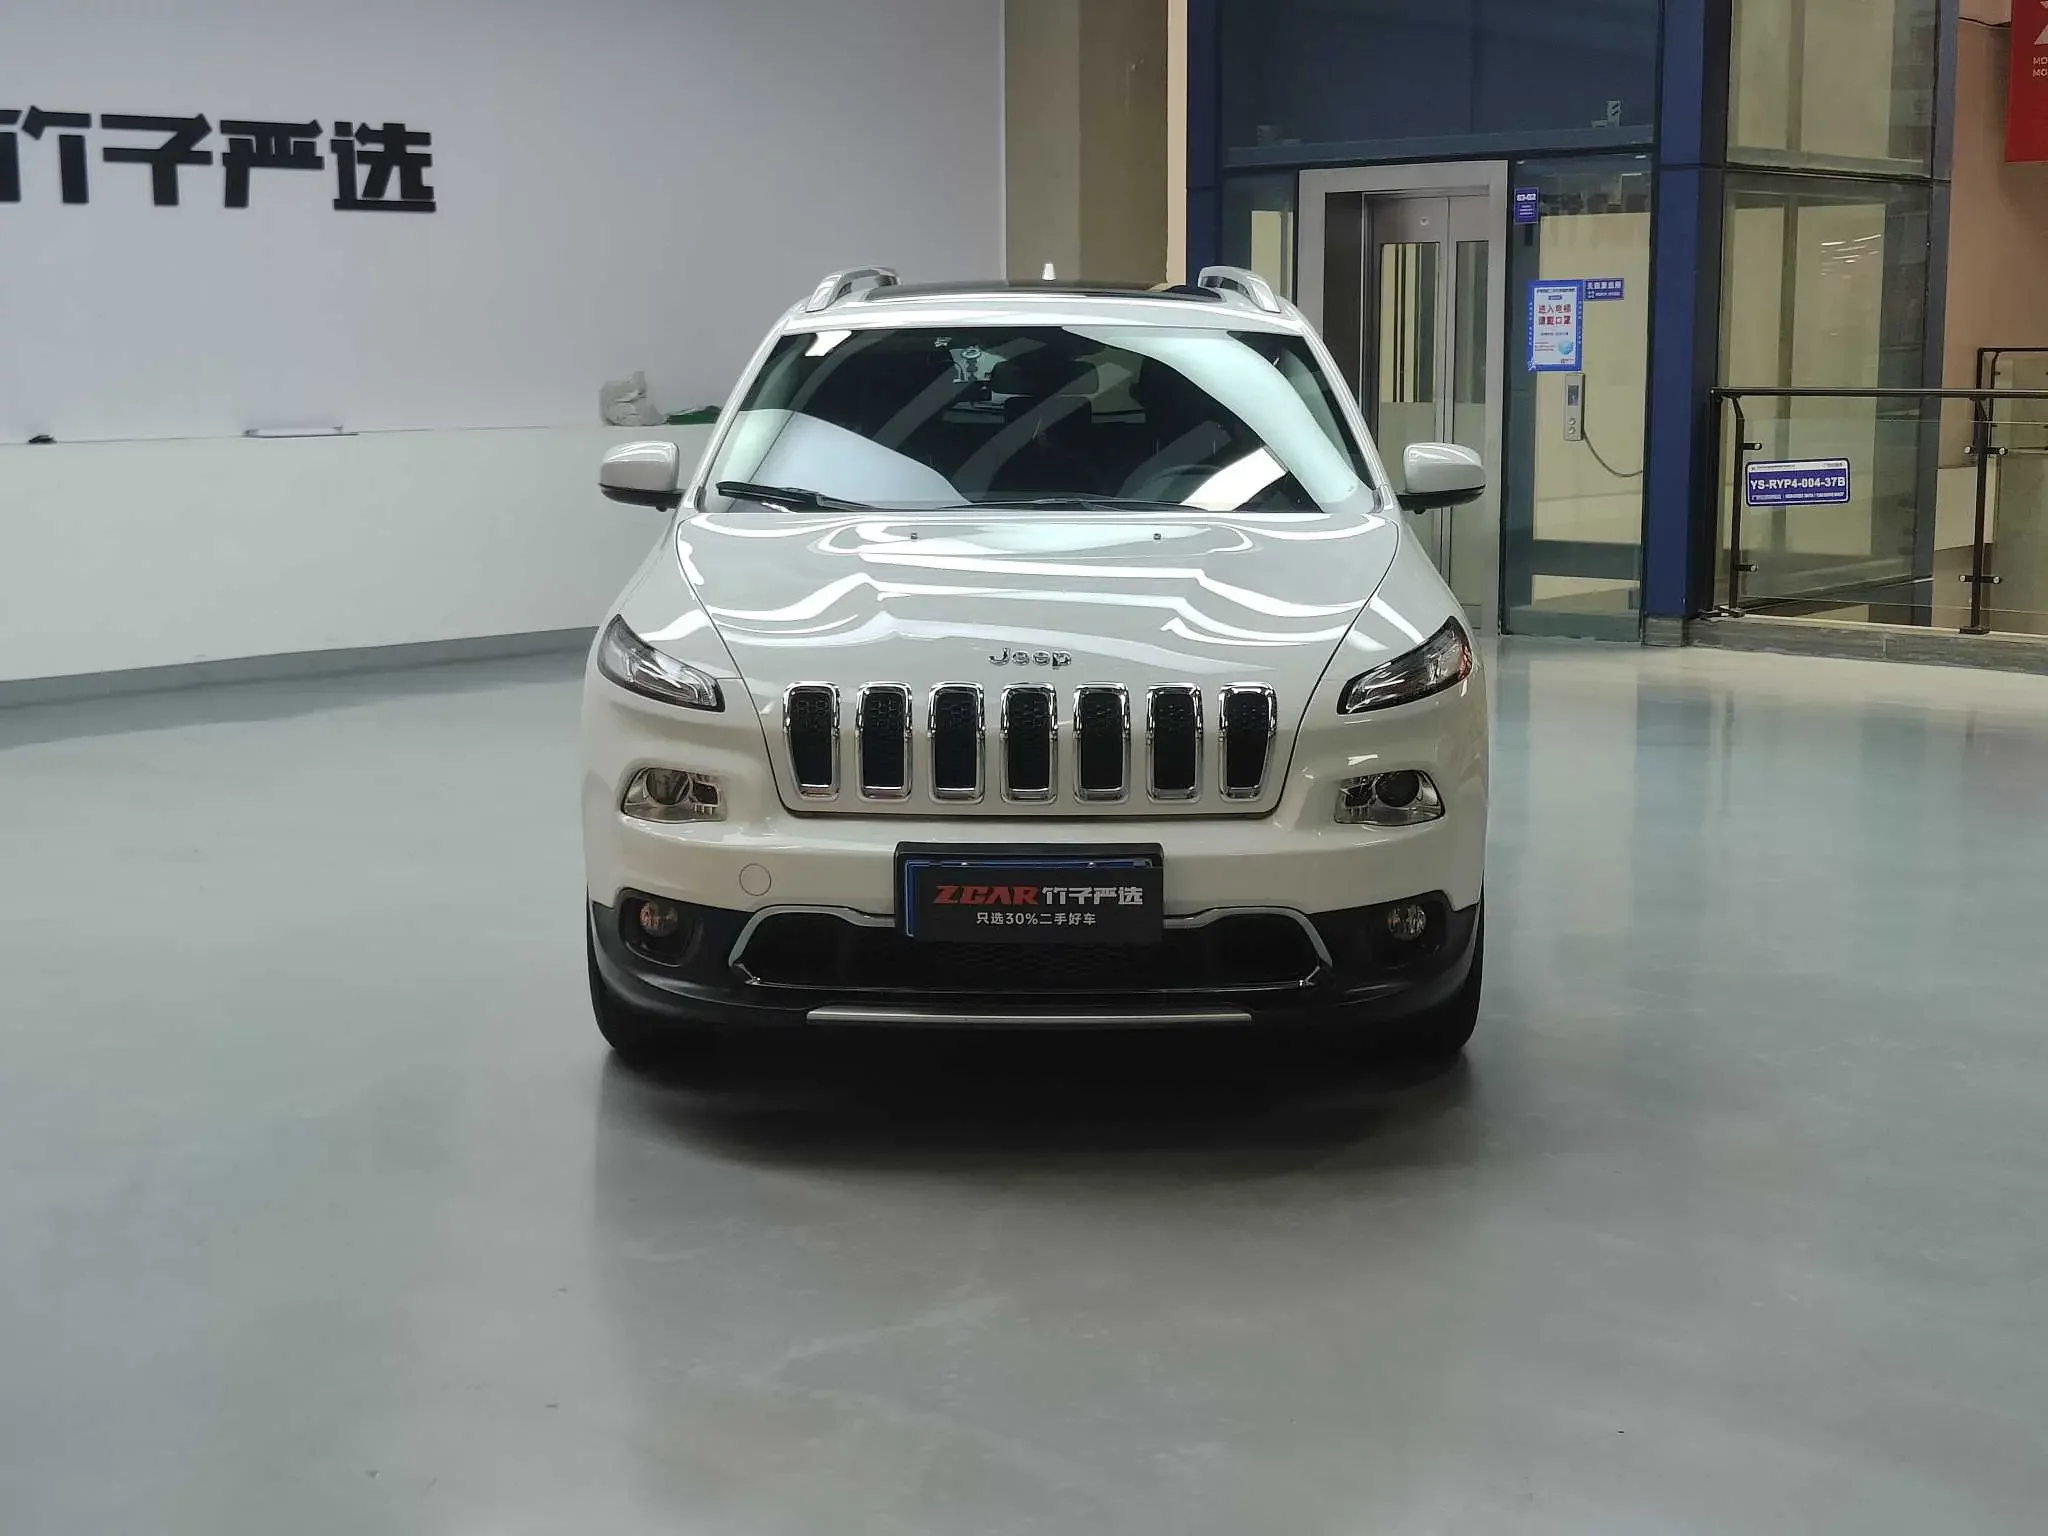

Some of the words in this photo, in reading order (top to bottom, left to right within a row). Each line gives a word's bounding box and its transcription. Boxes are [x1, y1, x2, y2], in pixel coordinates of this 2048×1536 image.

[1750, 476, 1846, 491] YS-RYP4-004-37B
[988, 647, 1072, 670] Jeep
[1042, 886, 1143, 905] 竹子严选
[976, 912, 1097, 926] 只选30%二手好车
